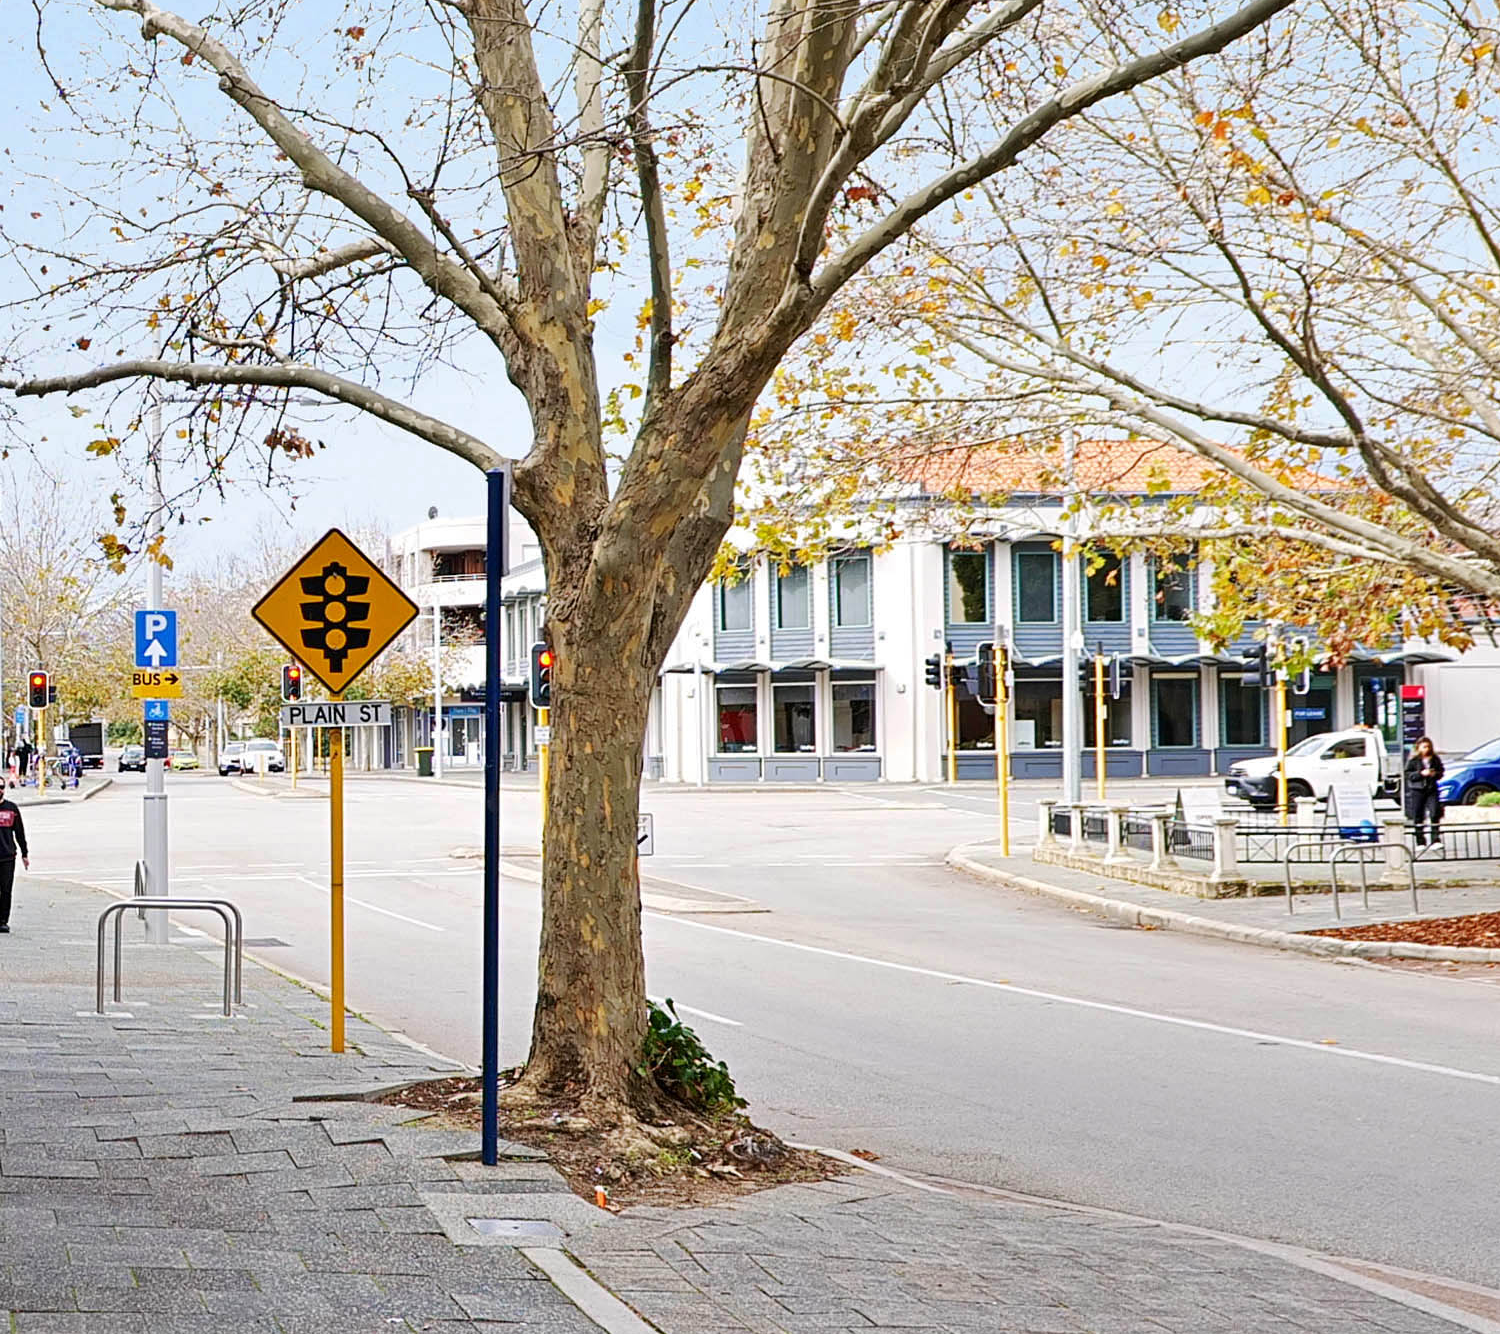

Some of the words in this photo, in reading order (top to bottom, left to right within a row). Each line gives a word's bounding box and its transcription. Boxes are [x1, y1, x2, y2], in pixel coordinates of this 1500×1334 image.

[145, 614, 167, 640] P
[132, 673, 161, 686] BUS
[289, 705, 346, 725] PLAIN
[360, 704, 382, 723] ST
